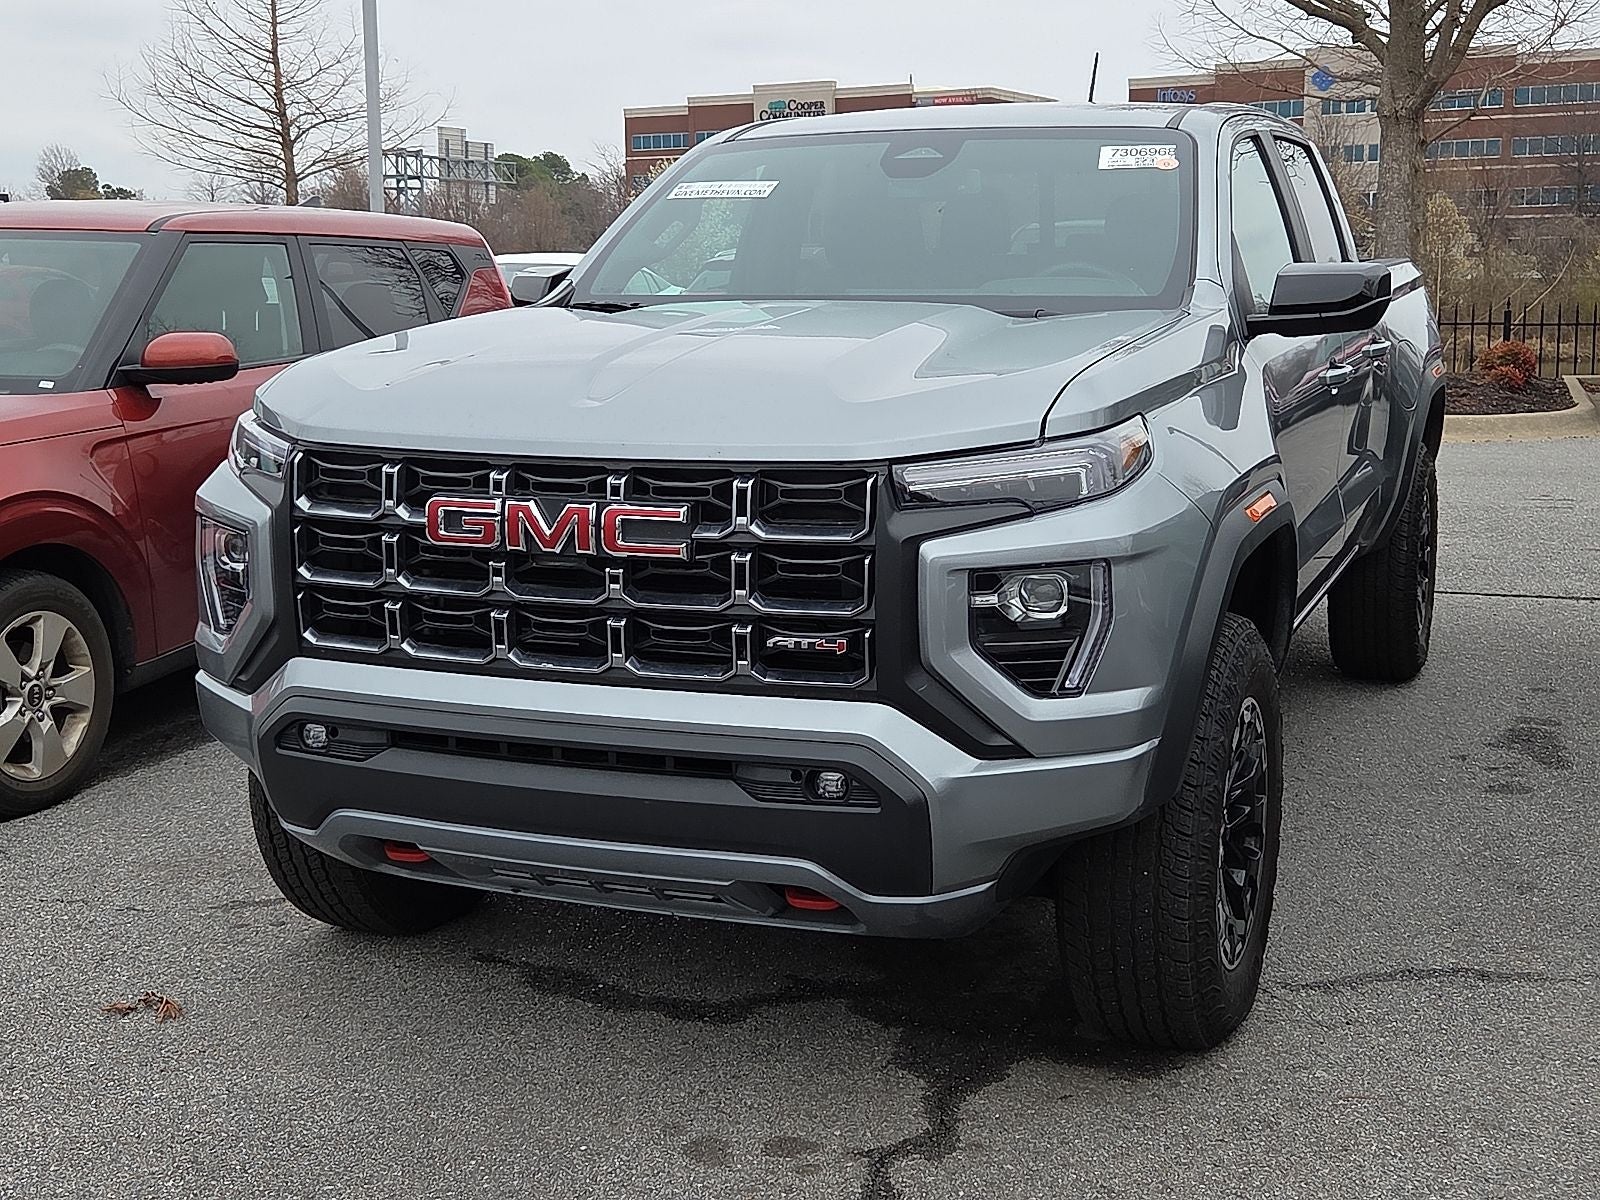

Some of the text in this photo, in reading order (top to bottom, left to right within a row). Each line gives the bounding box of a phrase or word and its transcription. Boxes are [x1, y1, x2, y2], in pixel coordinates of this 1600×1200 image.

[1157, 87, 1197, 103] Infosys
[787, 99, 826, 111] COOPER
[1110, 147, 1177, 158] 7306968
[674, 189, 767, 197] GIVEMETHEVIN.COM
[424, 495, 690, 561] GMC
[766, 636, 848, 655] AT4
